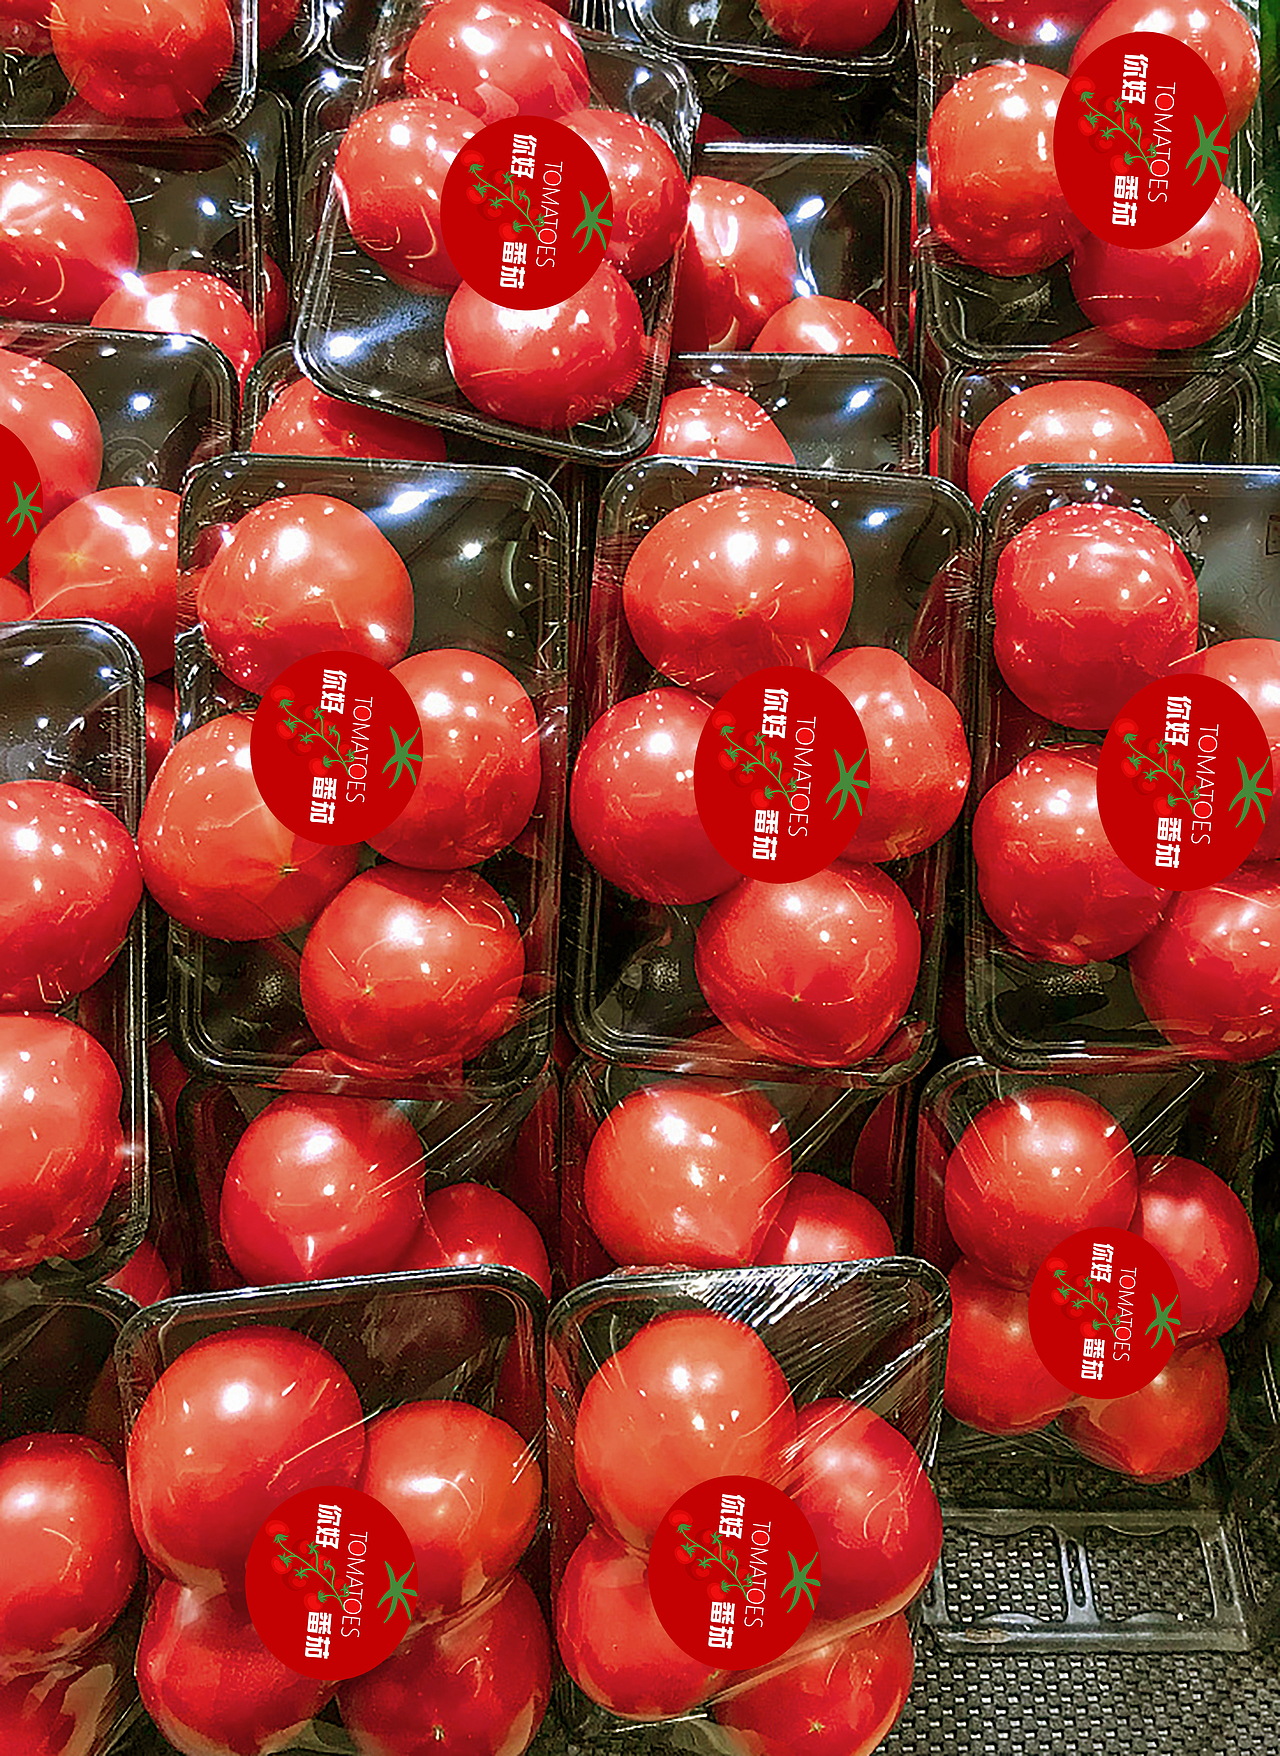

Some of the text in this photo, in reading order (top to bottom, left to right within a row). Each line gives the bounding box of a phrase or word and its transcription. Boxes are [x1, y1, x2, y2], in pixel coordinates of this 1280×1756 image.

[1112, 54, 1148, 226] 你好 番茄
[1148, 82, 1175, 202] TOMATOES
[500, 134, 537, 289] 你好 番茄
[536, 162, 563, 267] TOMATOES
[310, 669, 347, 824] 你好 番茄
[346, 697, 373, 802] TOMATOES
[753, 689, 788, 860] 你好 番茄
[788, 717, 816, 836] TOMATOES
[1155, 696, 1191, 868] 你好 番茄
[1191, 724, 1219, 844] TOMATOES
[1081, 1243, 1114, 1380] 你好 番茄
[1113, 1268, 1137, 1361] TOMATOES
[305, 1504, 342, 1659] 你好 番茄
[341, 1532, 367, 1637] TOMATOES
[708, 1494, 745, 1649] 你好 番茄
[744, 1522, 771, 1627] TOMATOES
